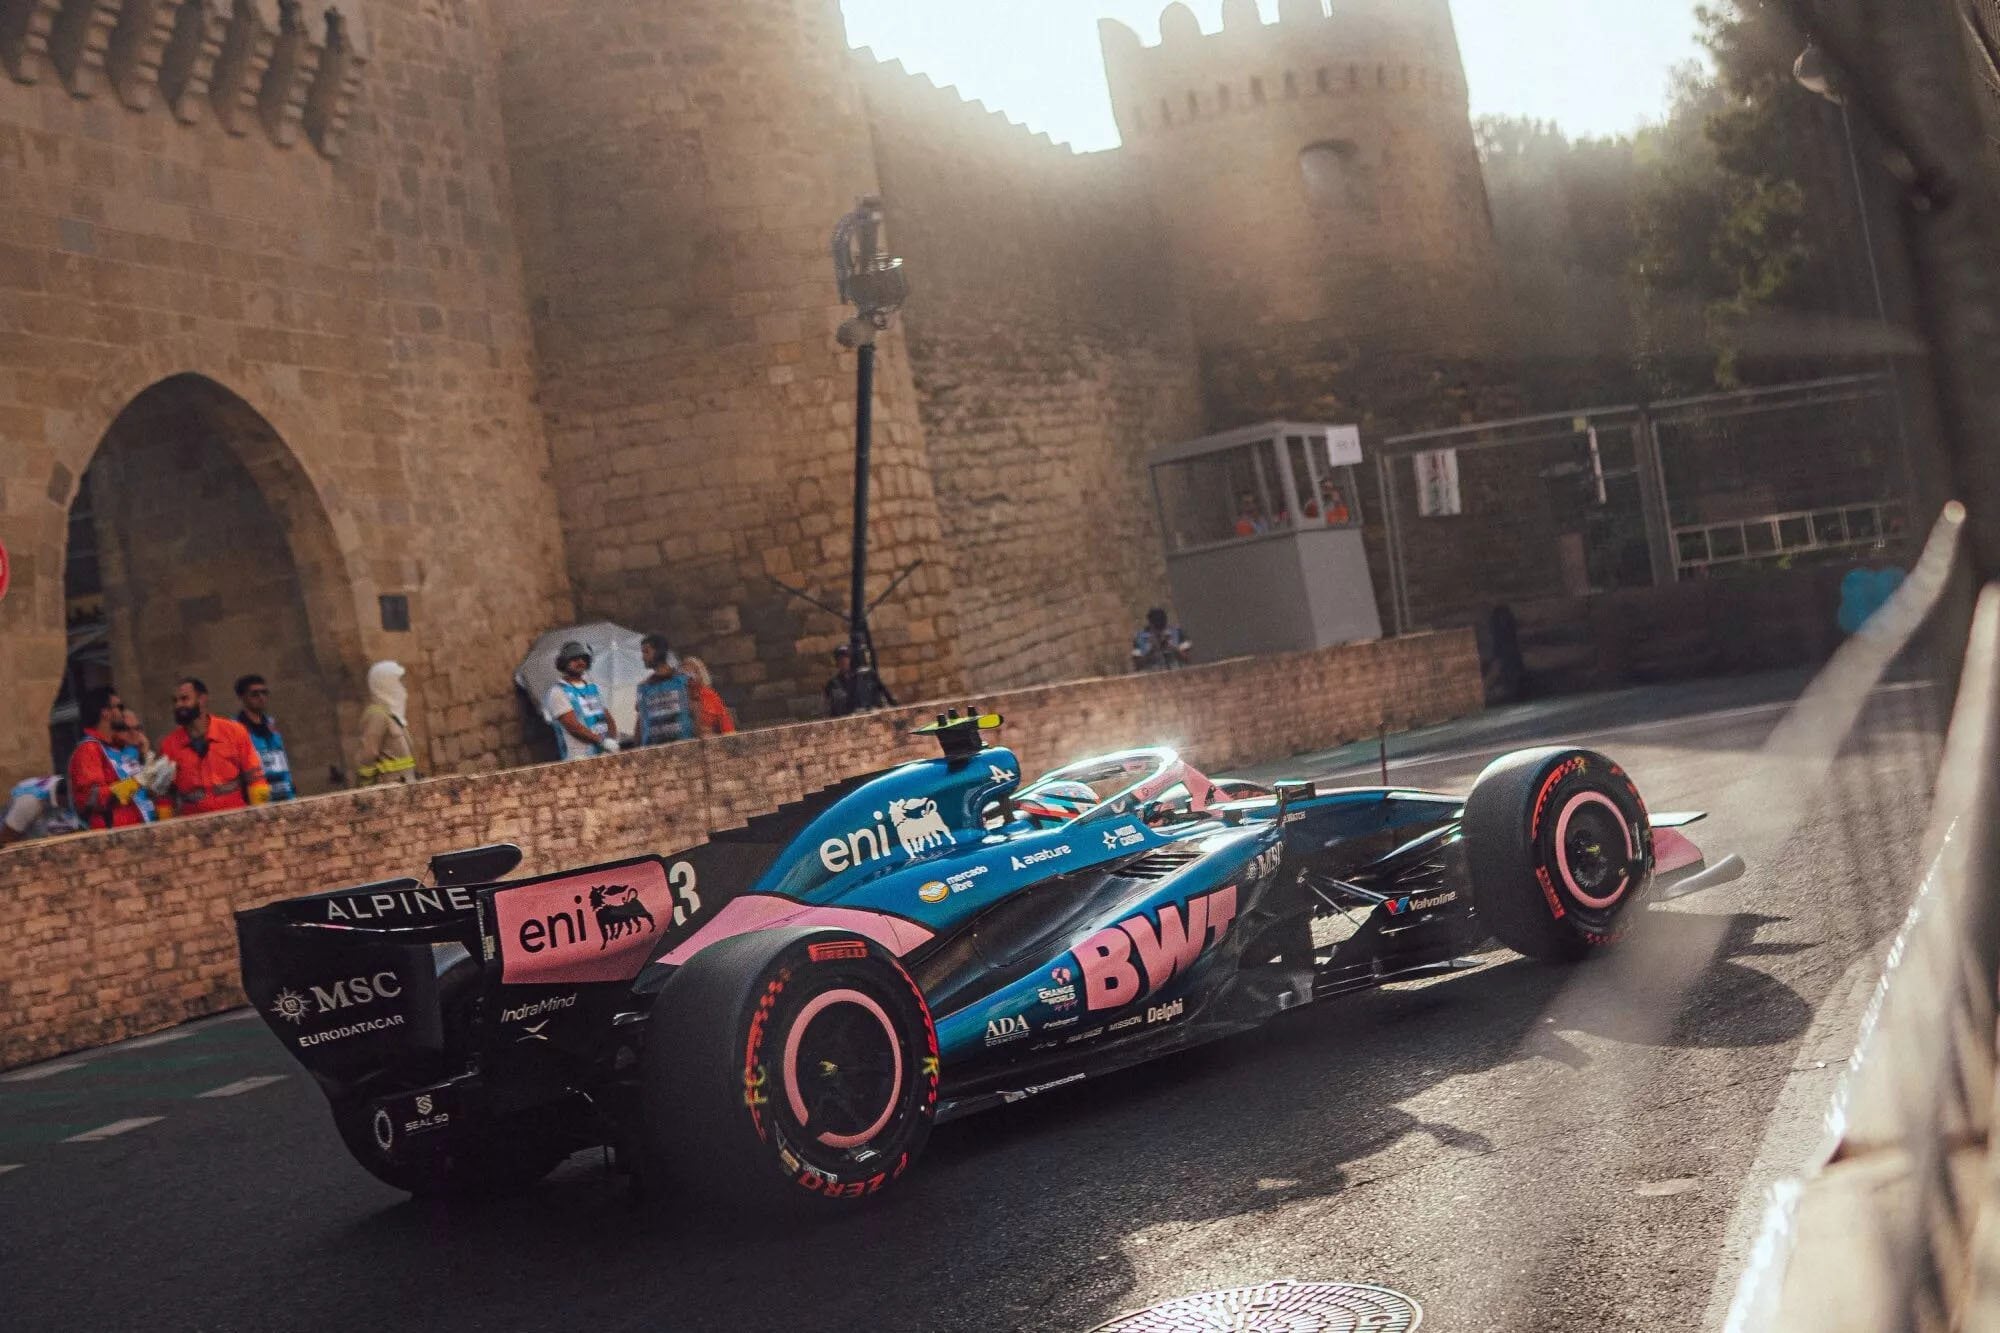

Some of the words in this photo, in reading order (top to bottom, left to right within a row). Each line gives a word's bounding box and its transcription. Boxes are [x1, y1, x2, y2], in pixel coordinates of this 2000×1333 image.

[820, 811, 892, 873] eni
[1022, 844, 1072, 866] avature
[946, 866, 988, 884] mercado
[951, 880, 975, 893] libre
[327, 886, 475, 921] ALPINE
[1408, 890, 1457, 912] Valvoline
[519, 895, 588, 954] eni
[1070, 884, 1238, 1012] BWT
[309, 971, 402, 1013] MSC
[501, 993, 577, 1023] IndraMind
[1146, 998, 1184, 1024] Delphi
[298, 1014, 405, 1048] EURODATACAR
[984, 1014, 1032, 1039] ADA
[1107, 1015, 1143, 1032] MISSION
